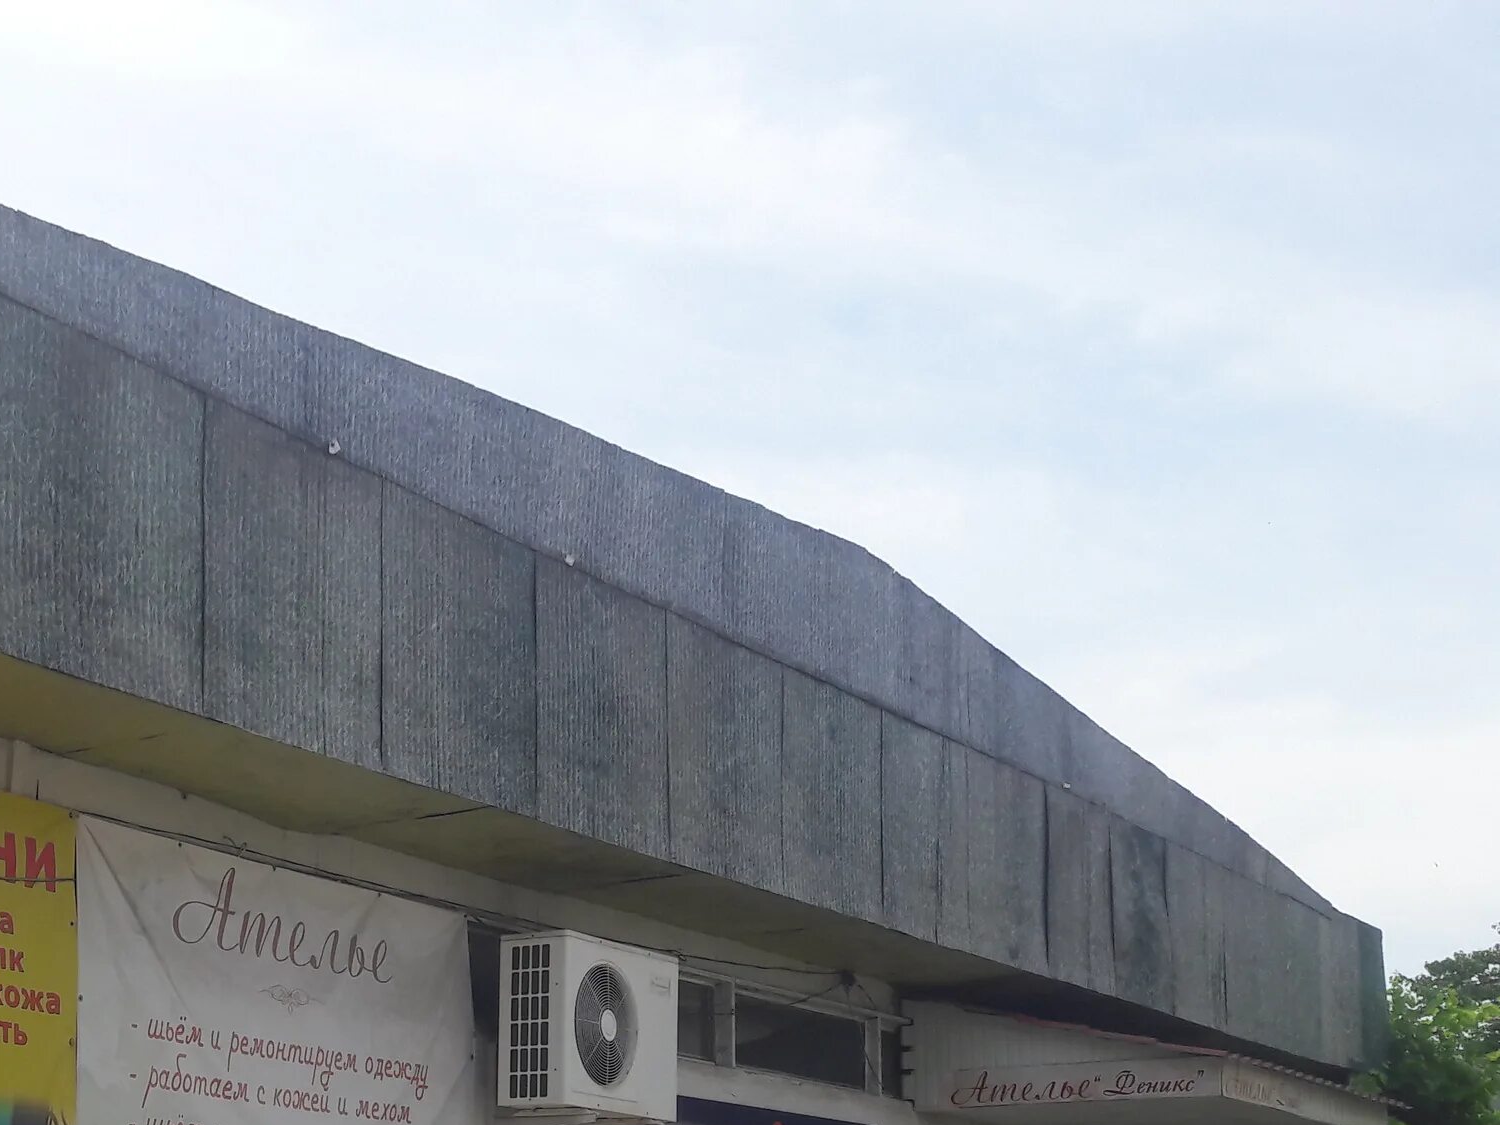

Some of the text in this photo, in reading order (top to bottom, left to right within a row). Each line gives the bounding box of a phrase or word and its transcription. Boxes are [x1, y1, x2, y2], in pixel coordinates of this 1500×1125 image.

[173, 867, 393, 983] Ателье
[142, 1054, 412, 1125] работаем с кожей и мехом
[147, 1017, 429, 1100] шьём и ремонтируем одежду
[951, 1070, 1092, 1107] Ателье
